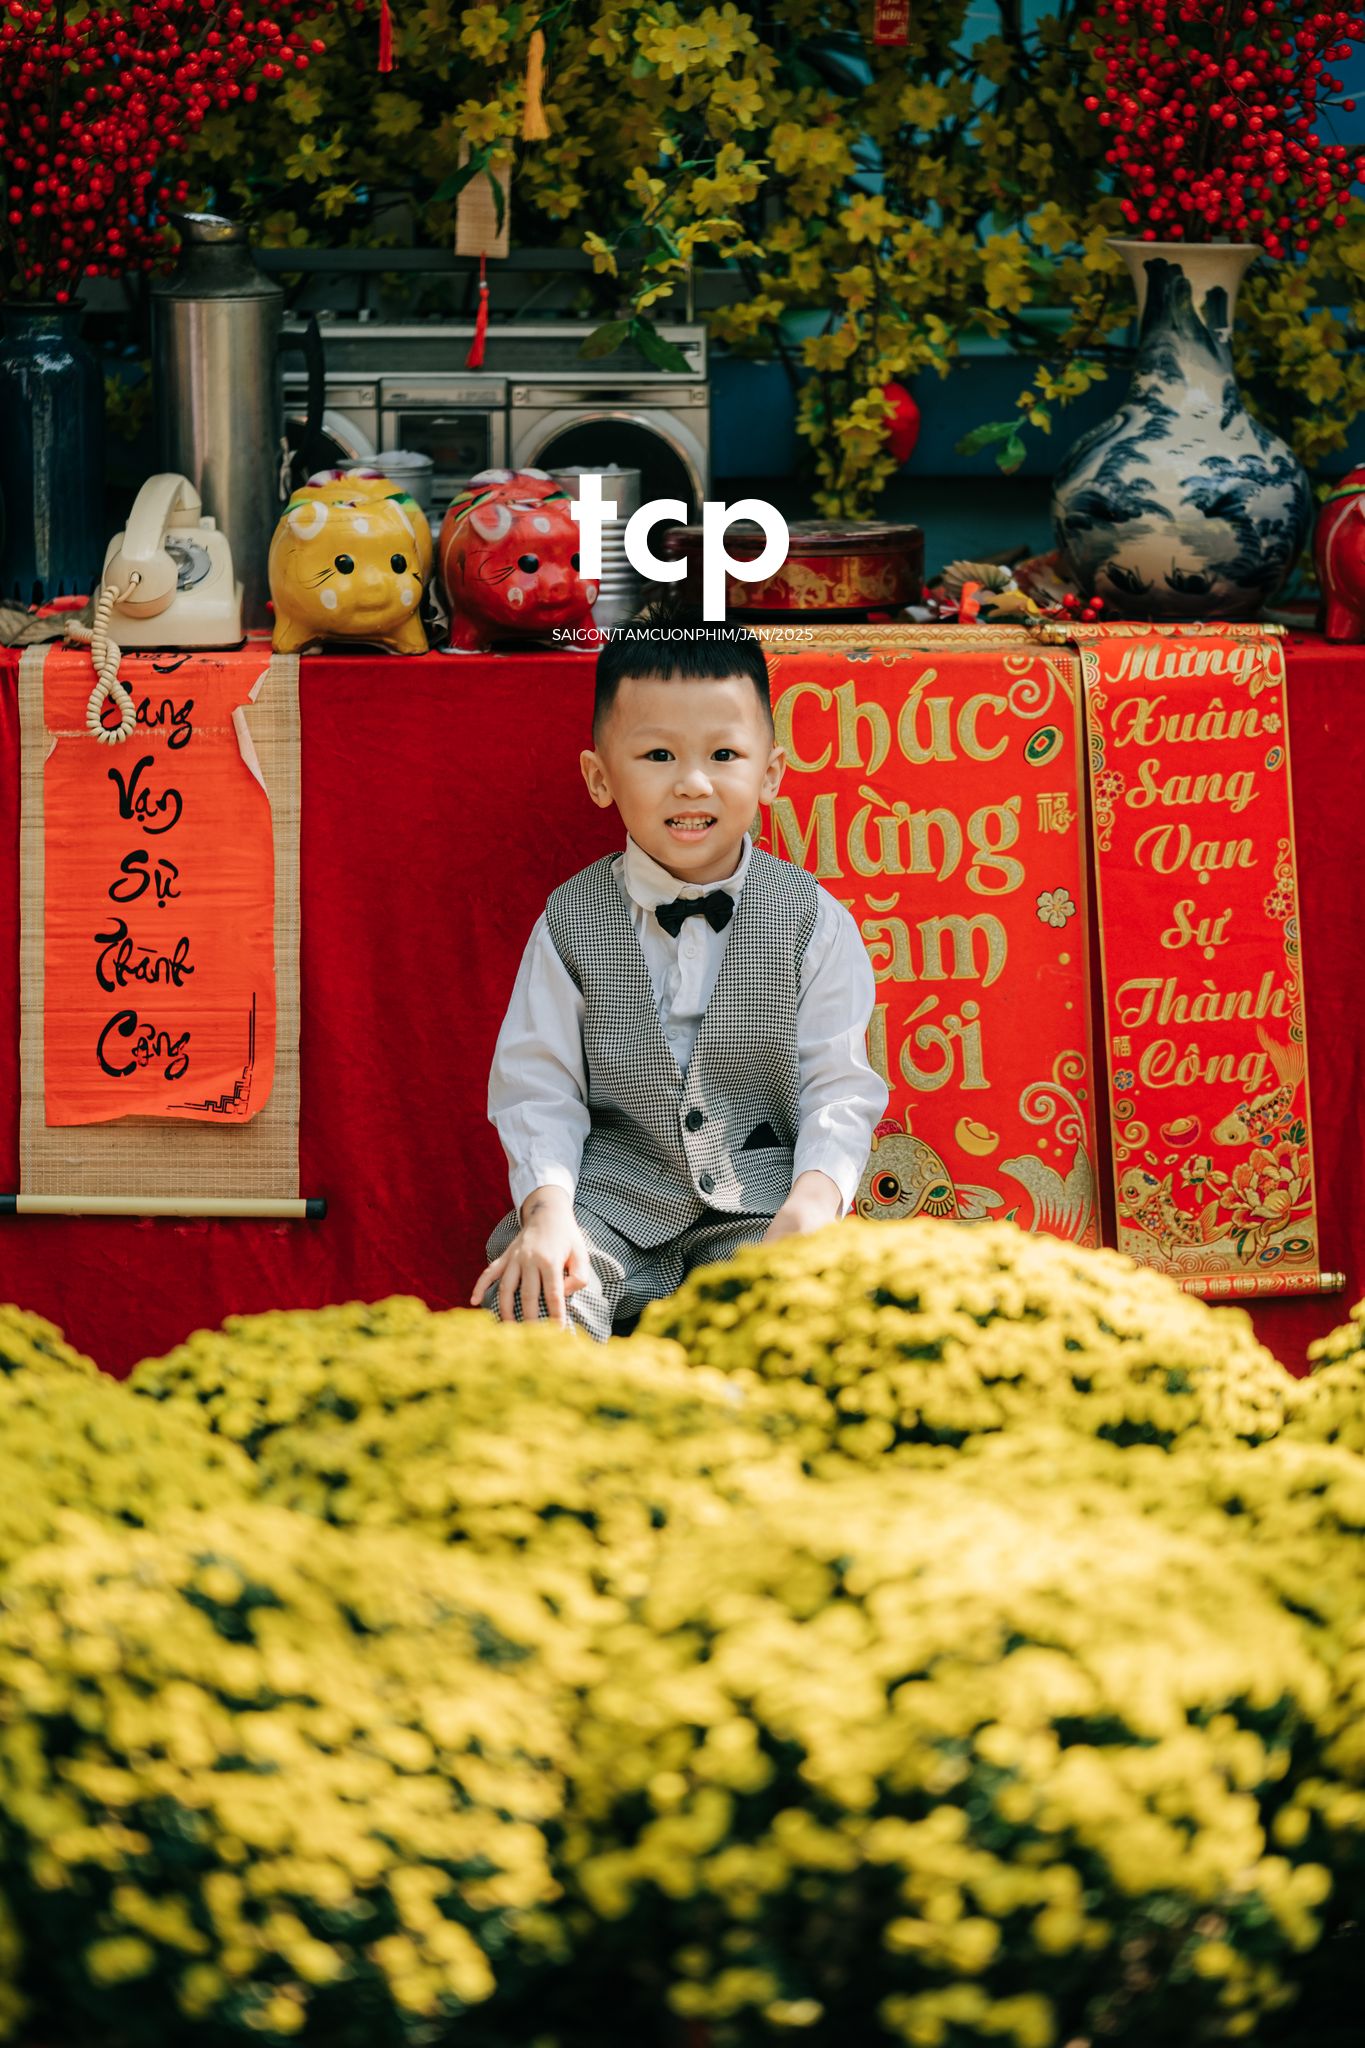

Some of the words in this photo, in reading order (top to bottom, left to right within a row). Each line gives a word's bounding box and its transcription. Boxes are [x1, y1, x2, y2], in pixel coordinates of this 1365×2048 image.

[1105, 644, 1263, 685] Mừng
[773, 668, 1009, 776] Chúc
[1111, 695, 1264, 747] Xuân
[108, 755, 183, 834] Vạn
[1125, 758, 1260, 813] Sang
[771, 785, 1025, 895] Mừng
[1134, 824, 1258, 884] Vạn
[108, 850, 181, 908] Sự
[94, 917, 195, 992] Thành
[845, 892, 1008, 988] ăm
[1160, 900, 1233, 960] Sự
[1115, 971, 1291, 1028] Thành
[1139, 1039, 1273, 1093] Công
